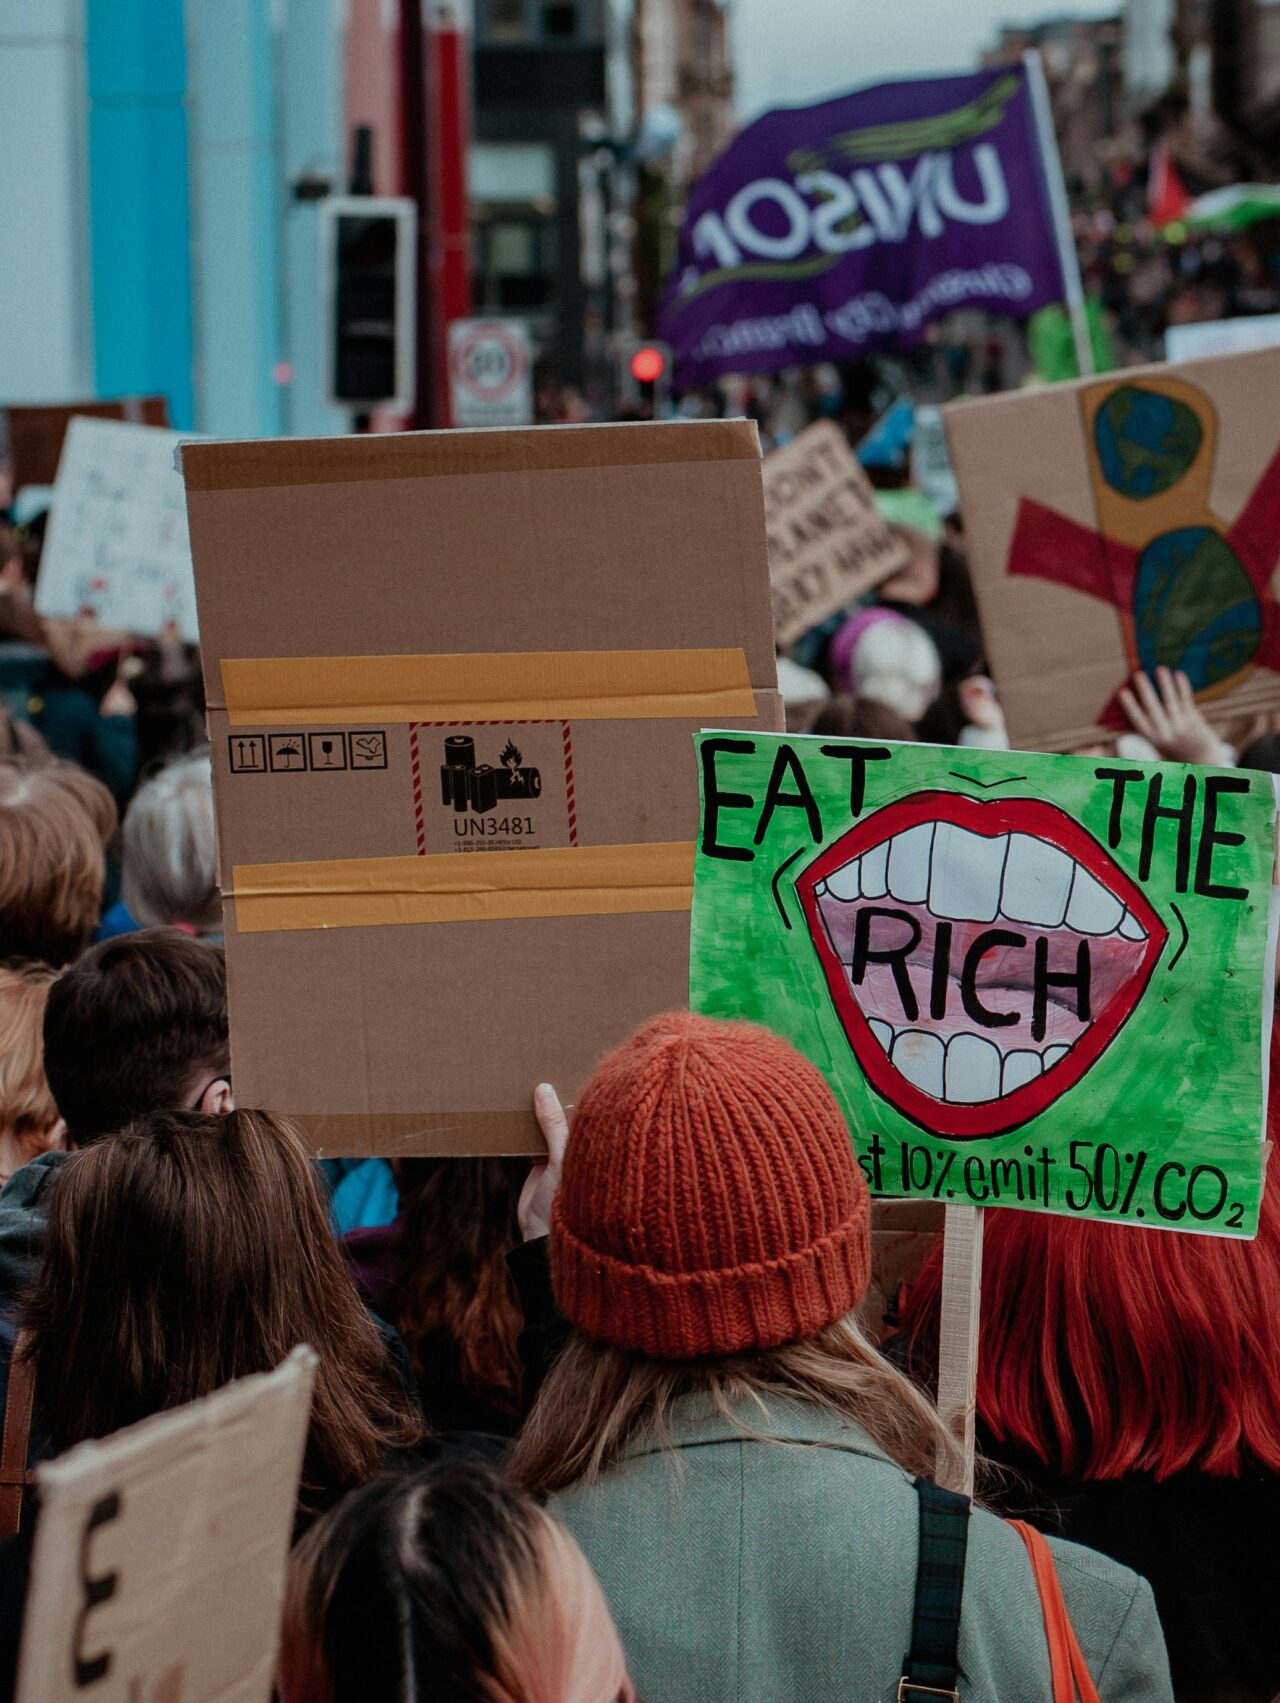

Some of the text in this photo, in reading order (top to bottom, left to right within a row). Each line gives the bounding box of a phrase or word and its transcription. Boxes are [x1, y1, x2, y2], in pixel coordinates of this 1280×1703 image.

[453, 816, 535, 837] UN3481
[699, 739, 1251, 901] EAT THE
[851, 907, 1091, 1043] RICH
[901, 1141, 956, 1199] 10%
[964, 1144, 1058, 1207] emit
[1065, 1139, 1148, 1219] 50%
